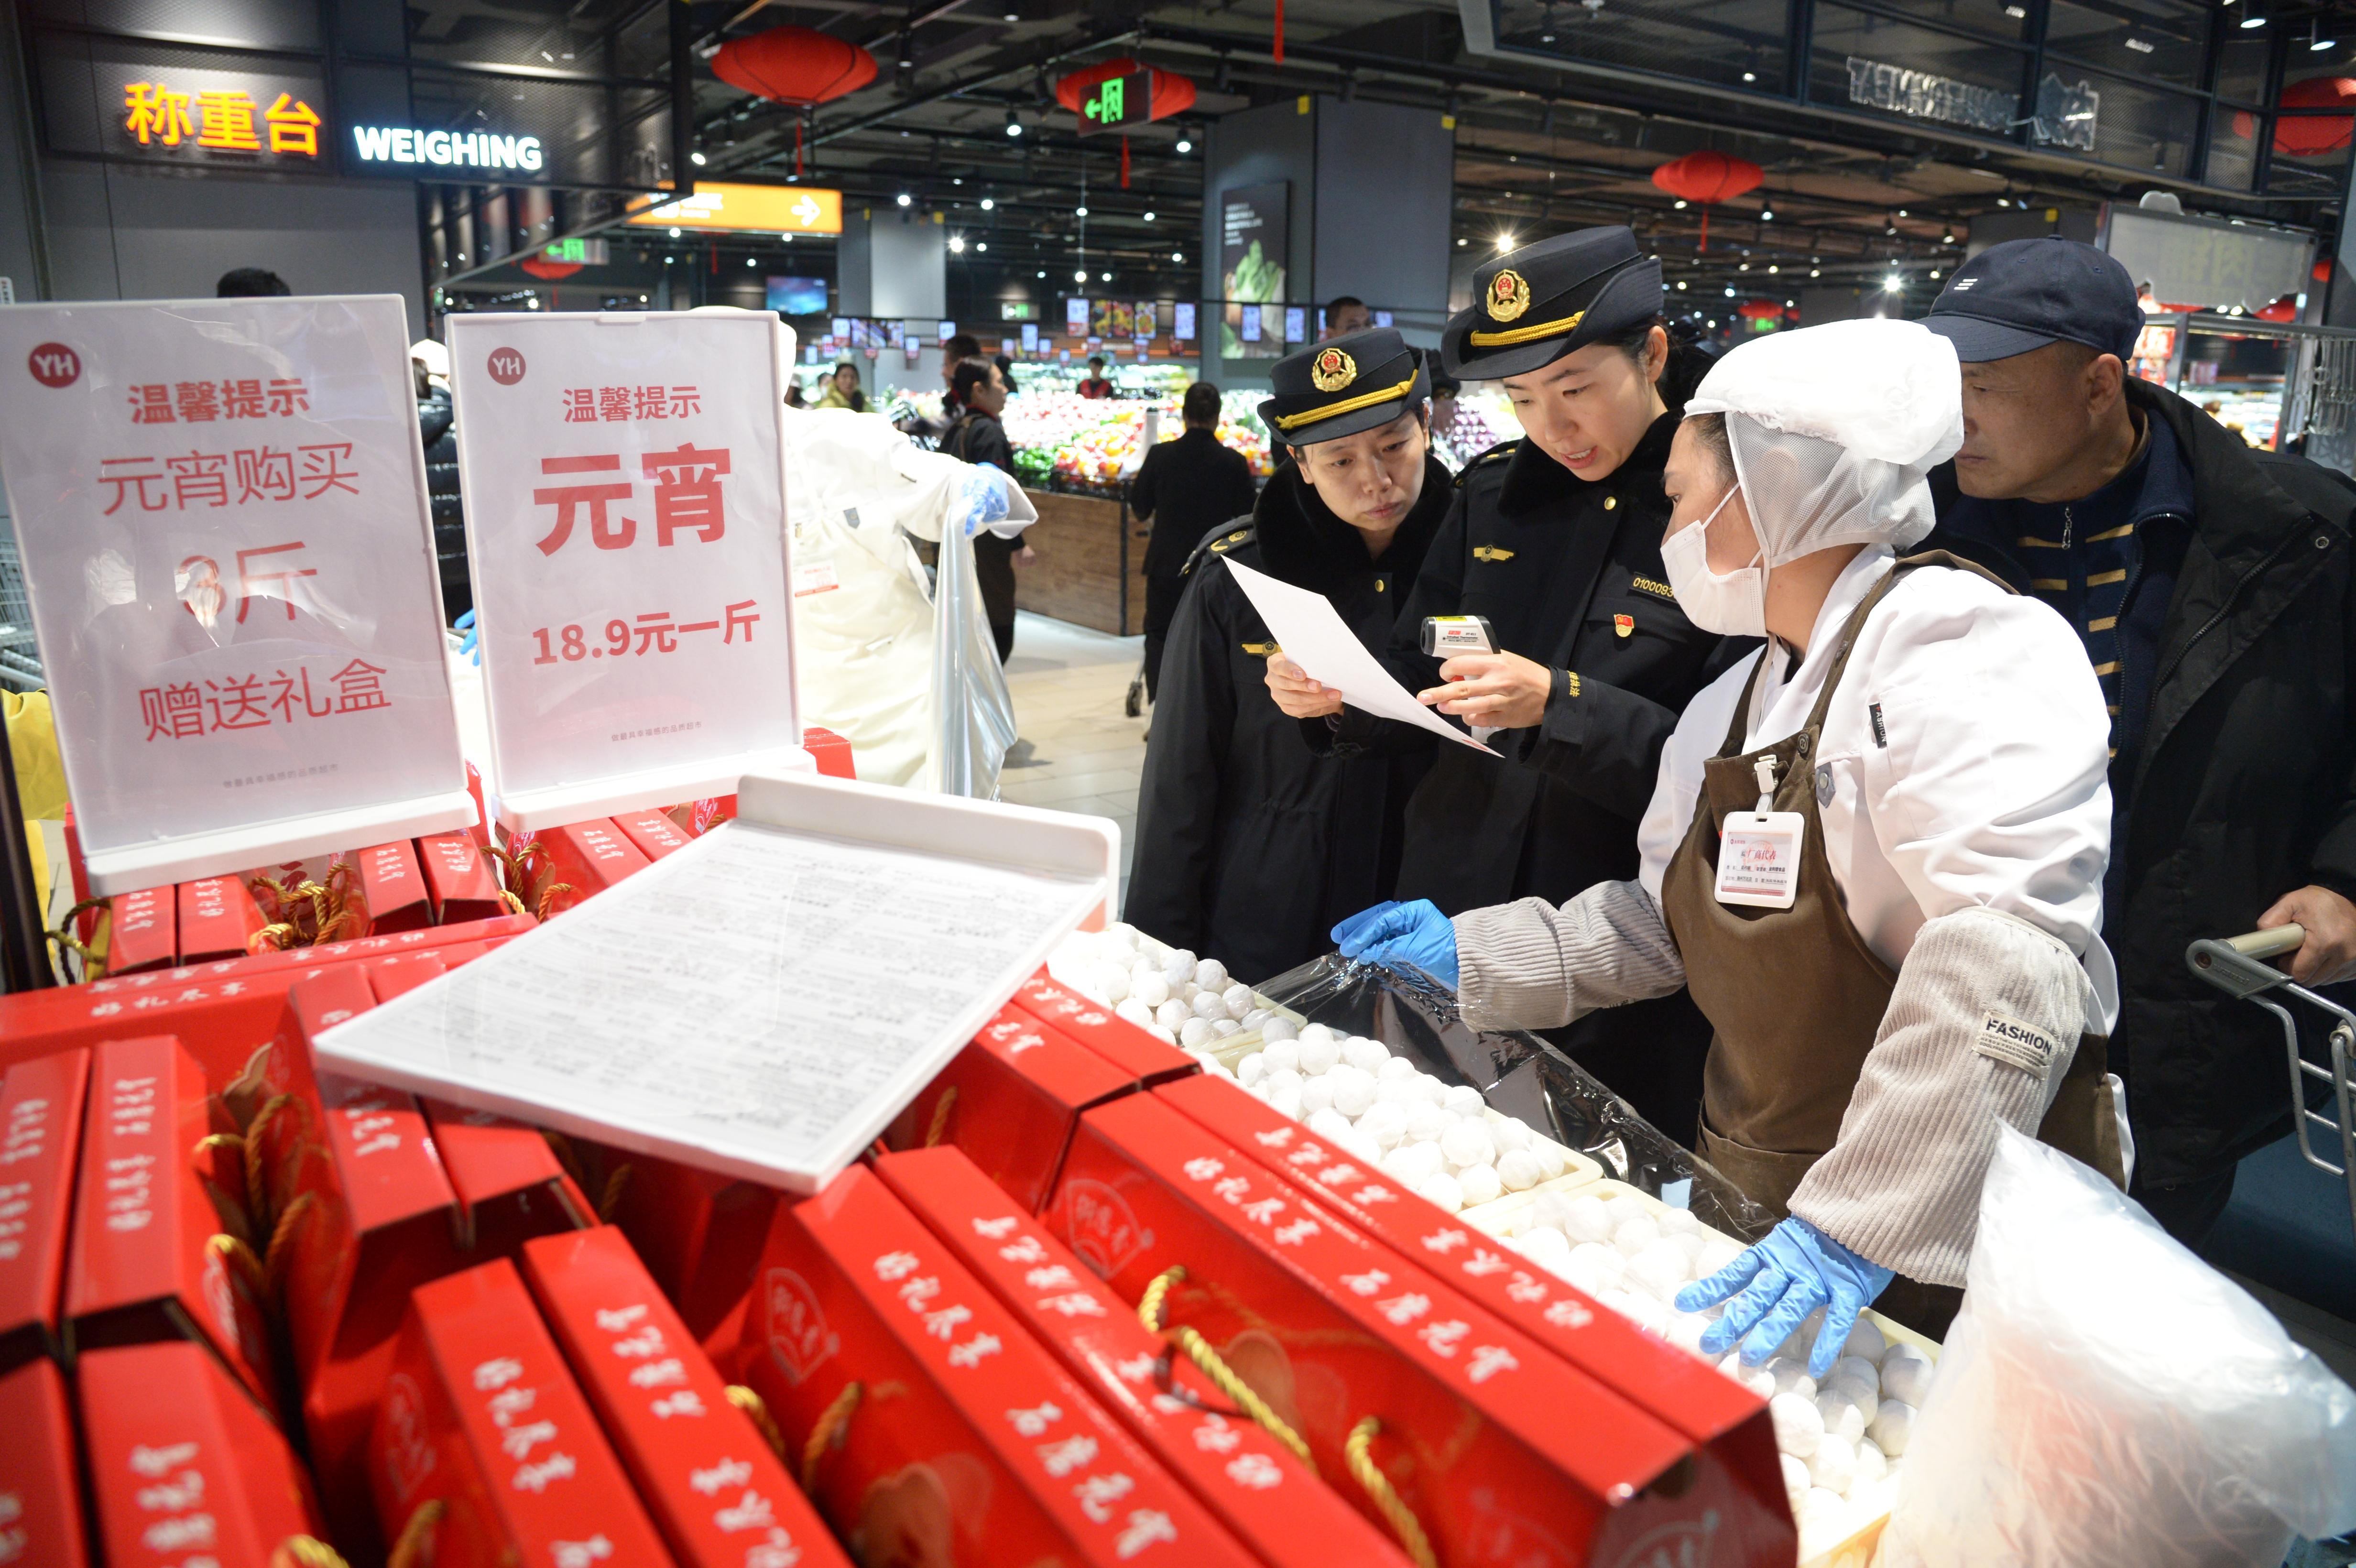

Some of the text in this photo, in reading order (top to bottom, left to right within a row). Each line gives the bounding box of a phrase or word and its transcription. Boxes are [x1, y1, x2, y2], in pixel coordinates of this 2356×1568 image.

[124, 81, 322, 156] 称重台
[354, 126, 542, 170] WEIGHING
[34, 352, 76, 378] YH
[492, 357, 521, 375] YH
[128, 378, 310, 424] 温馨提示
[562, 386, 701, 423] 温馨提示
[97, 443, 360, 516] 元宵购买
[533, 442, 731, 556] 元宵
[1633, 577, 1674, 597] 0100093
[532, 599, 762, 665] 18.9元一斤
[139, 658, 391, 743] 赠送礼盒
[611, 720, 702, 742] 做最具幸福感的品质超市
[1747, 849, 1777, 860] 厂商代表
[1986, 1018, 2052, 1056] FASHION
